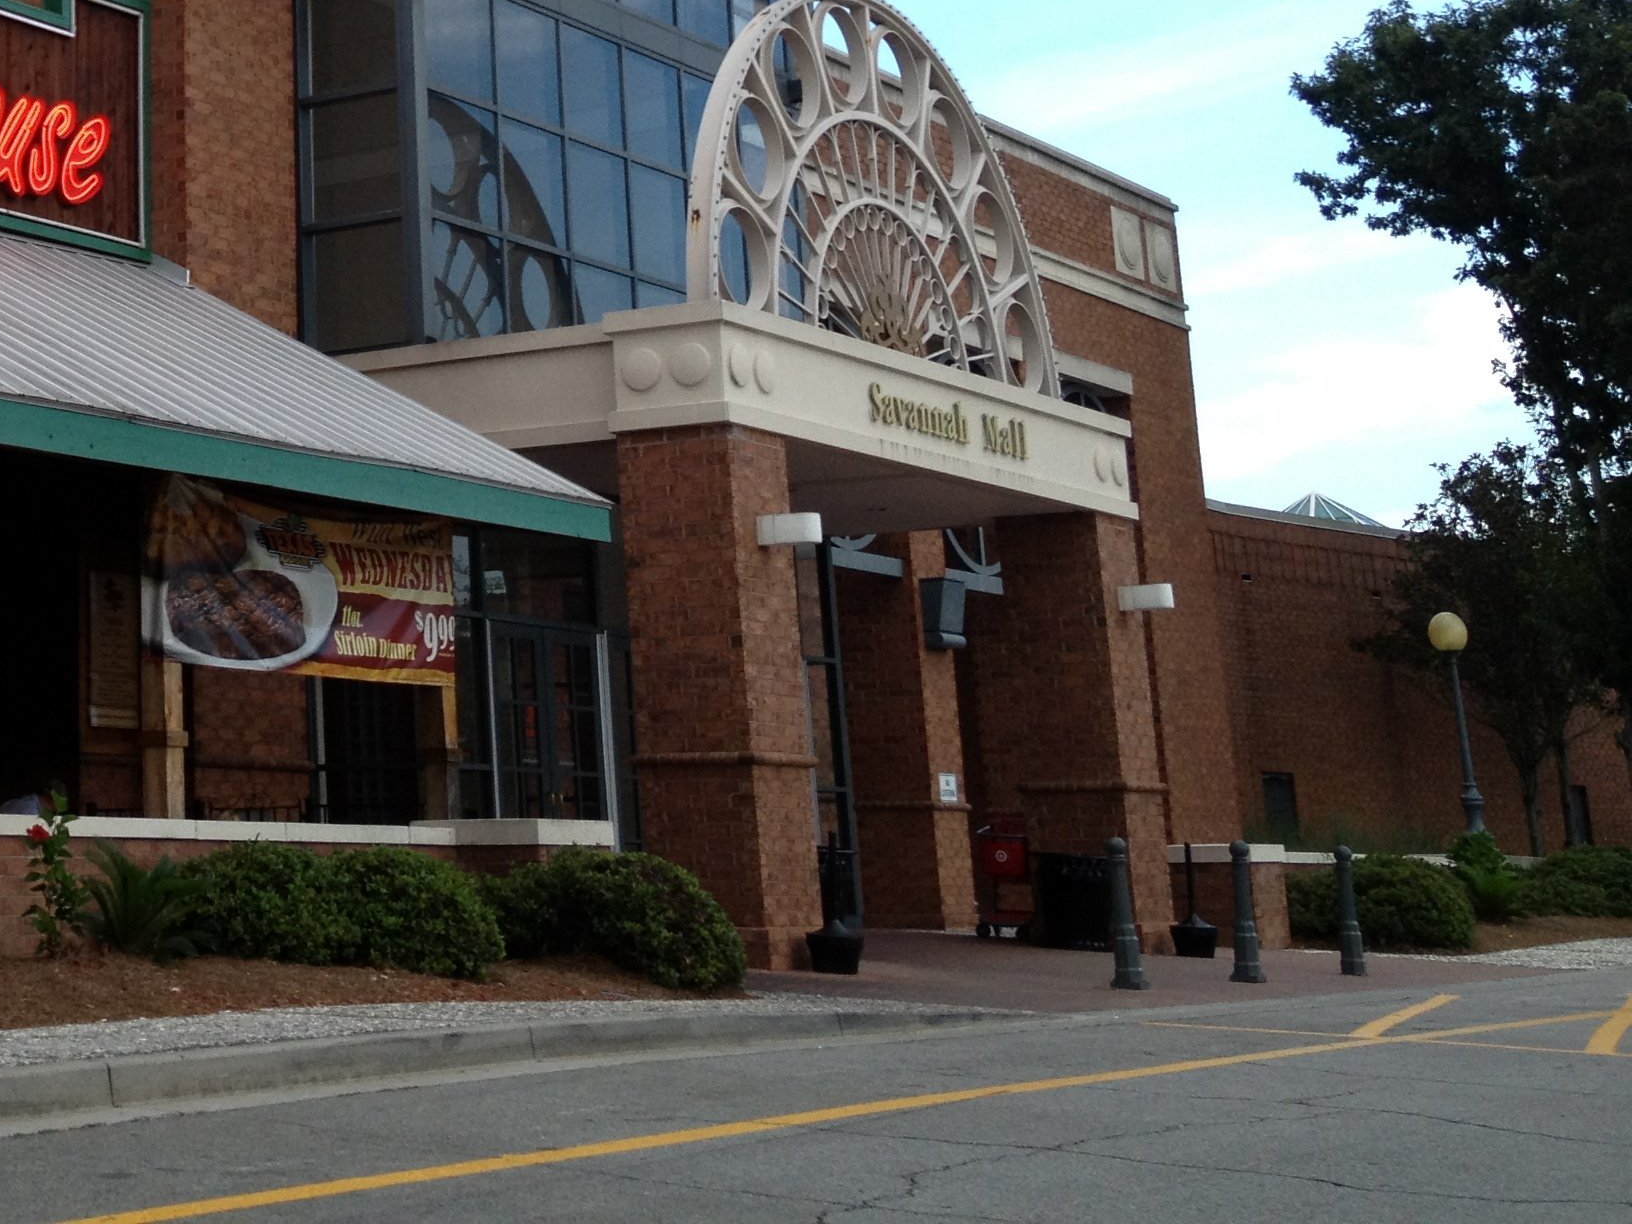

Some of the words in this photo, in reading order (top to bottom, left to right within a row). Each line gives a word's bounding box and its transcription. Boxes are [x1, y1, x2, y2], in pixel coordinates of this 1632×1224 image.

[869, 381, 970, 445] Savannah
[981, 412, 1029, 462] Mall
[334, 630, 377, 658] Sirloin
[378, 638, 418, 661] Dinner
